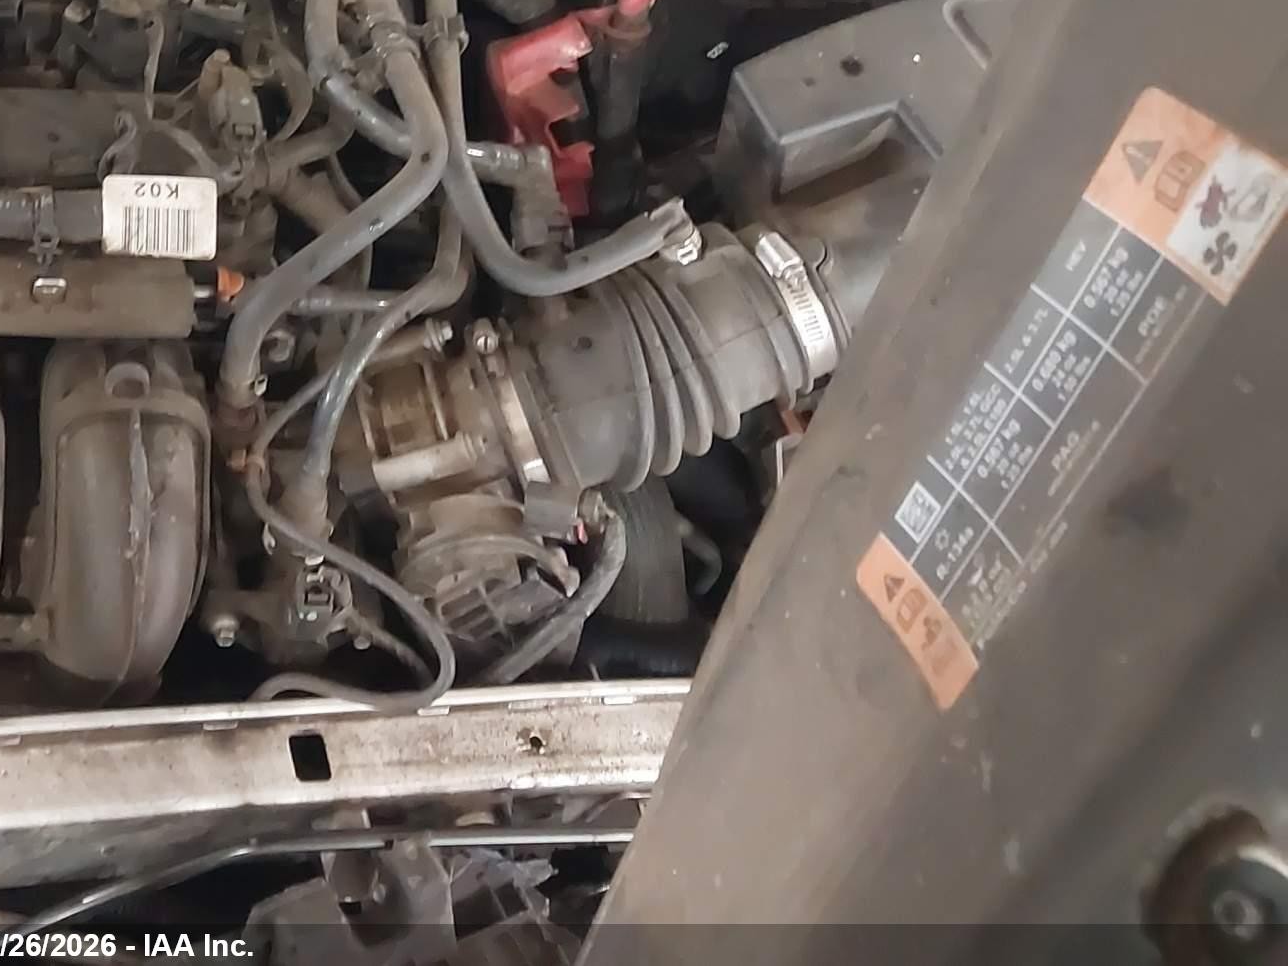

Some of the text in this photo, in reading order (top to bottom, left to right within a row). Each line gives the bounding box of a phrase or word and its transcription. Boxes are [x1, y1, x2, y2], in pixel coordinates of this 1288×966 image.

[134, 183, 179, 199] K02
[1108, 245, 1130, 270] kg
[1056, 327, 1078, 354] kg
[1001, 416, 1021, 442] kg
[936, 524, 973, 580] R-134a
